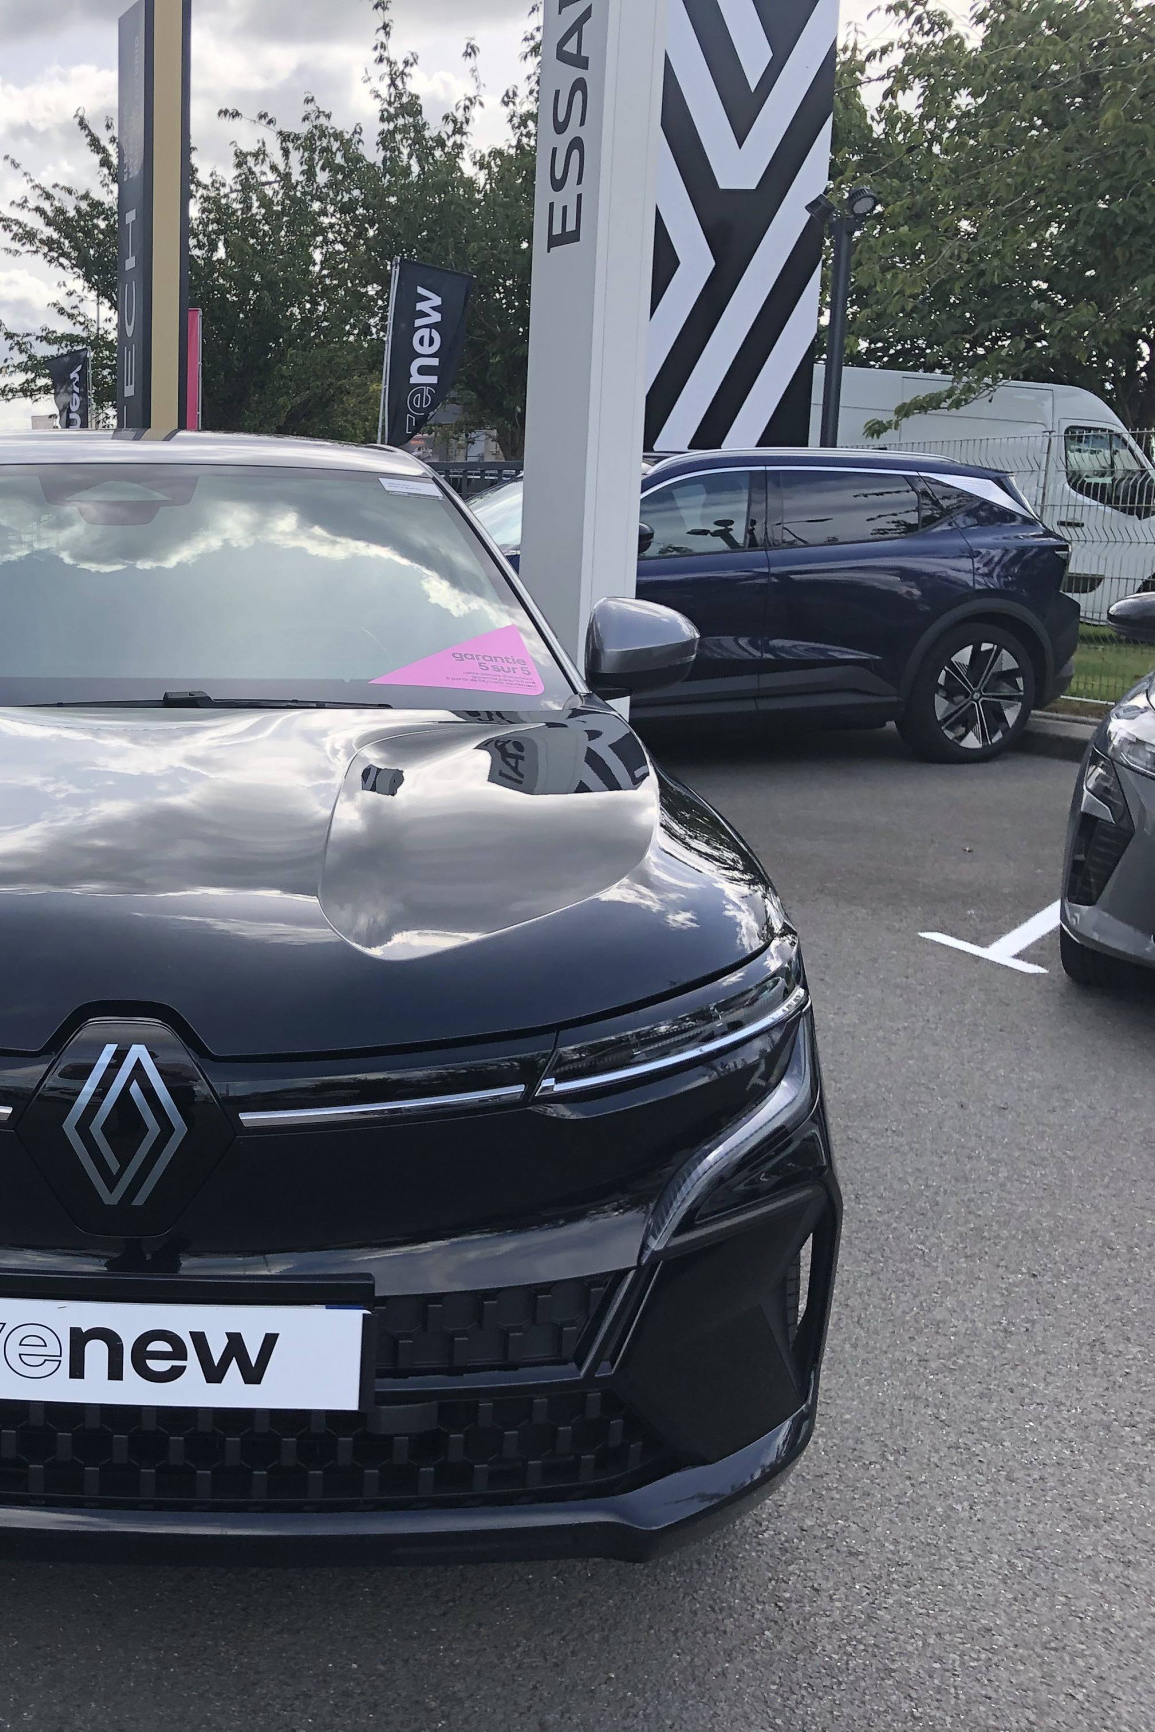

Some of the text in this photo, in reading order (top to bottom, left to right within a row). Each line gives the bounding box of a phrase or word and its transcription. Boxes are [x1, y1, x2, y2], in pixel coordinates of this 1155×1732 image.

[406, 285, 442, 434] renew
[451, 652, 526, 666] garantie
[478, 662, 489, 671] 5
[491, 664, 518, 674] sur
[521, 667, 532, 676] 5
